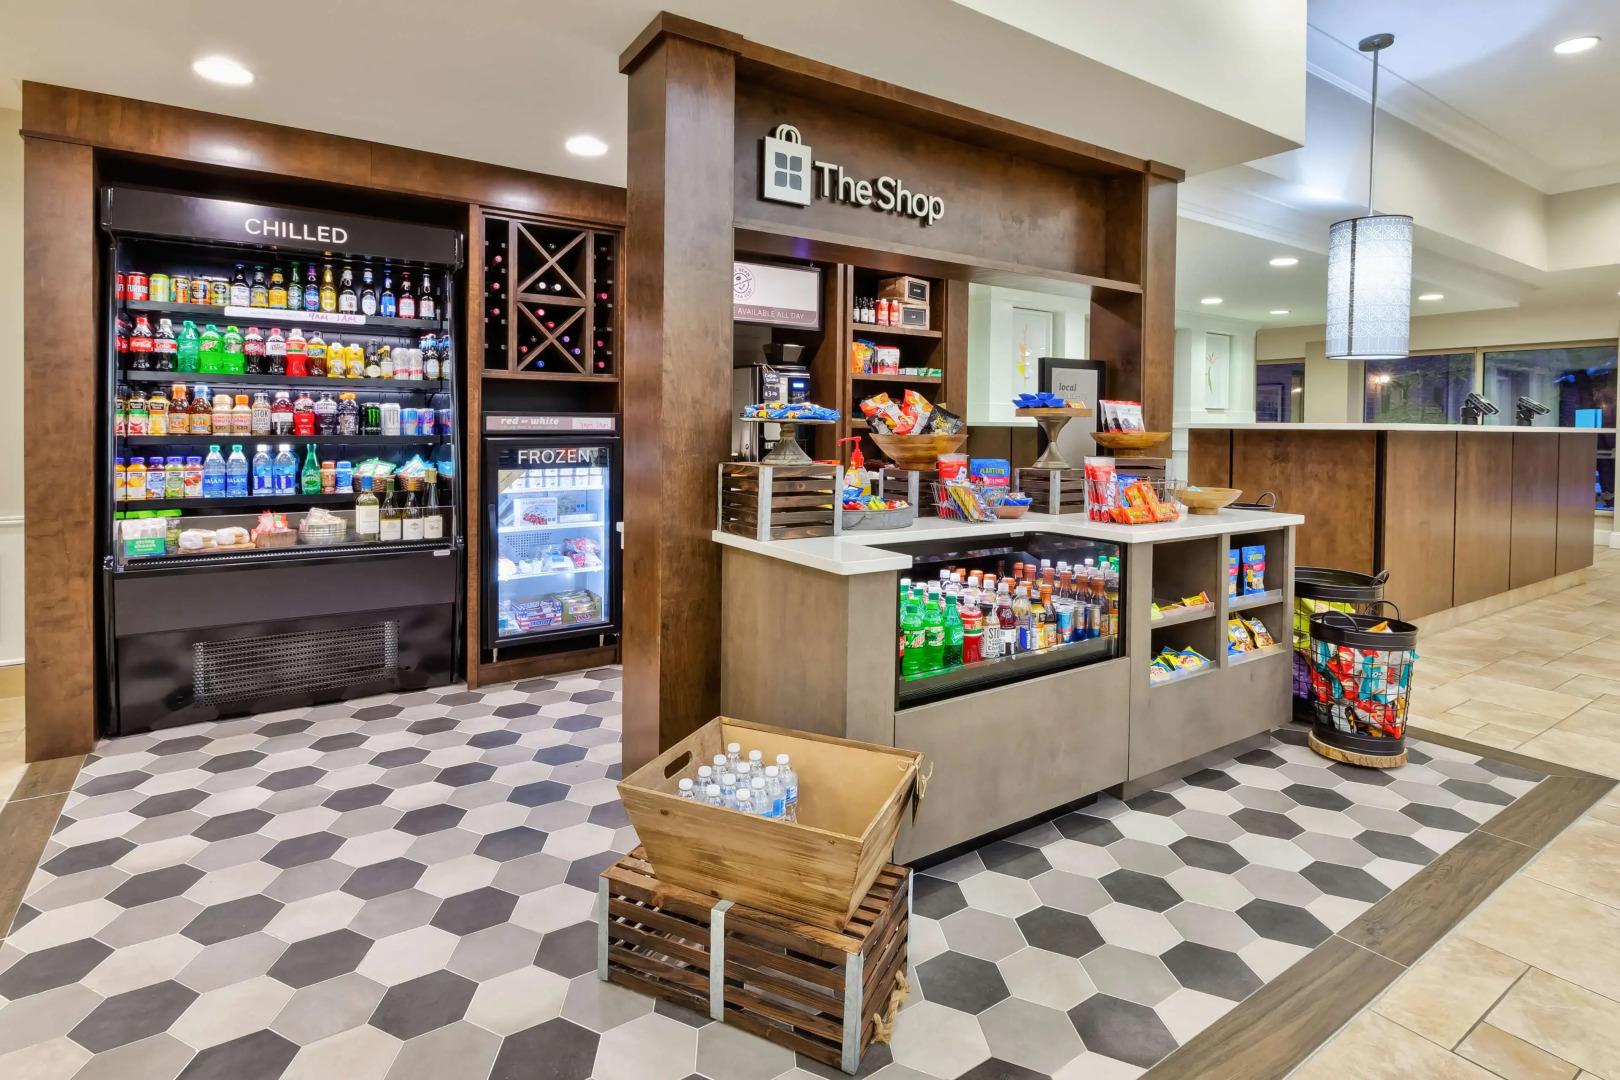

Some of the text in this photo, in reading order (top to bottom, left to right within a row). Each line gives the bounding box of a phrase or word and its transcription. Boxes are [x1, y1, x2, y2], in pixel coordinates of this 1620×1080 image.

[244, 218, 348, 244] CHILLED
[737, 307, 775, 318] AVAILABLE
[777, 311, 790, 319] ALL
[790, 312, 805, 320] DAY
[1059, 383, 1077, 392] local
[500, 416, 519, 425] red
[530, 416, 560, 425] white
[517, 449, 590, 465] FROZEN
